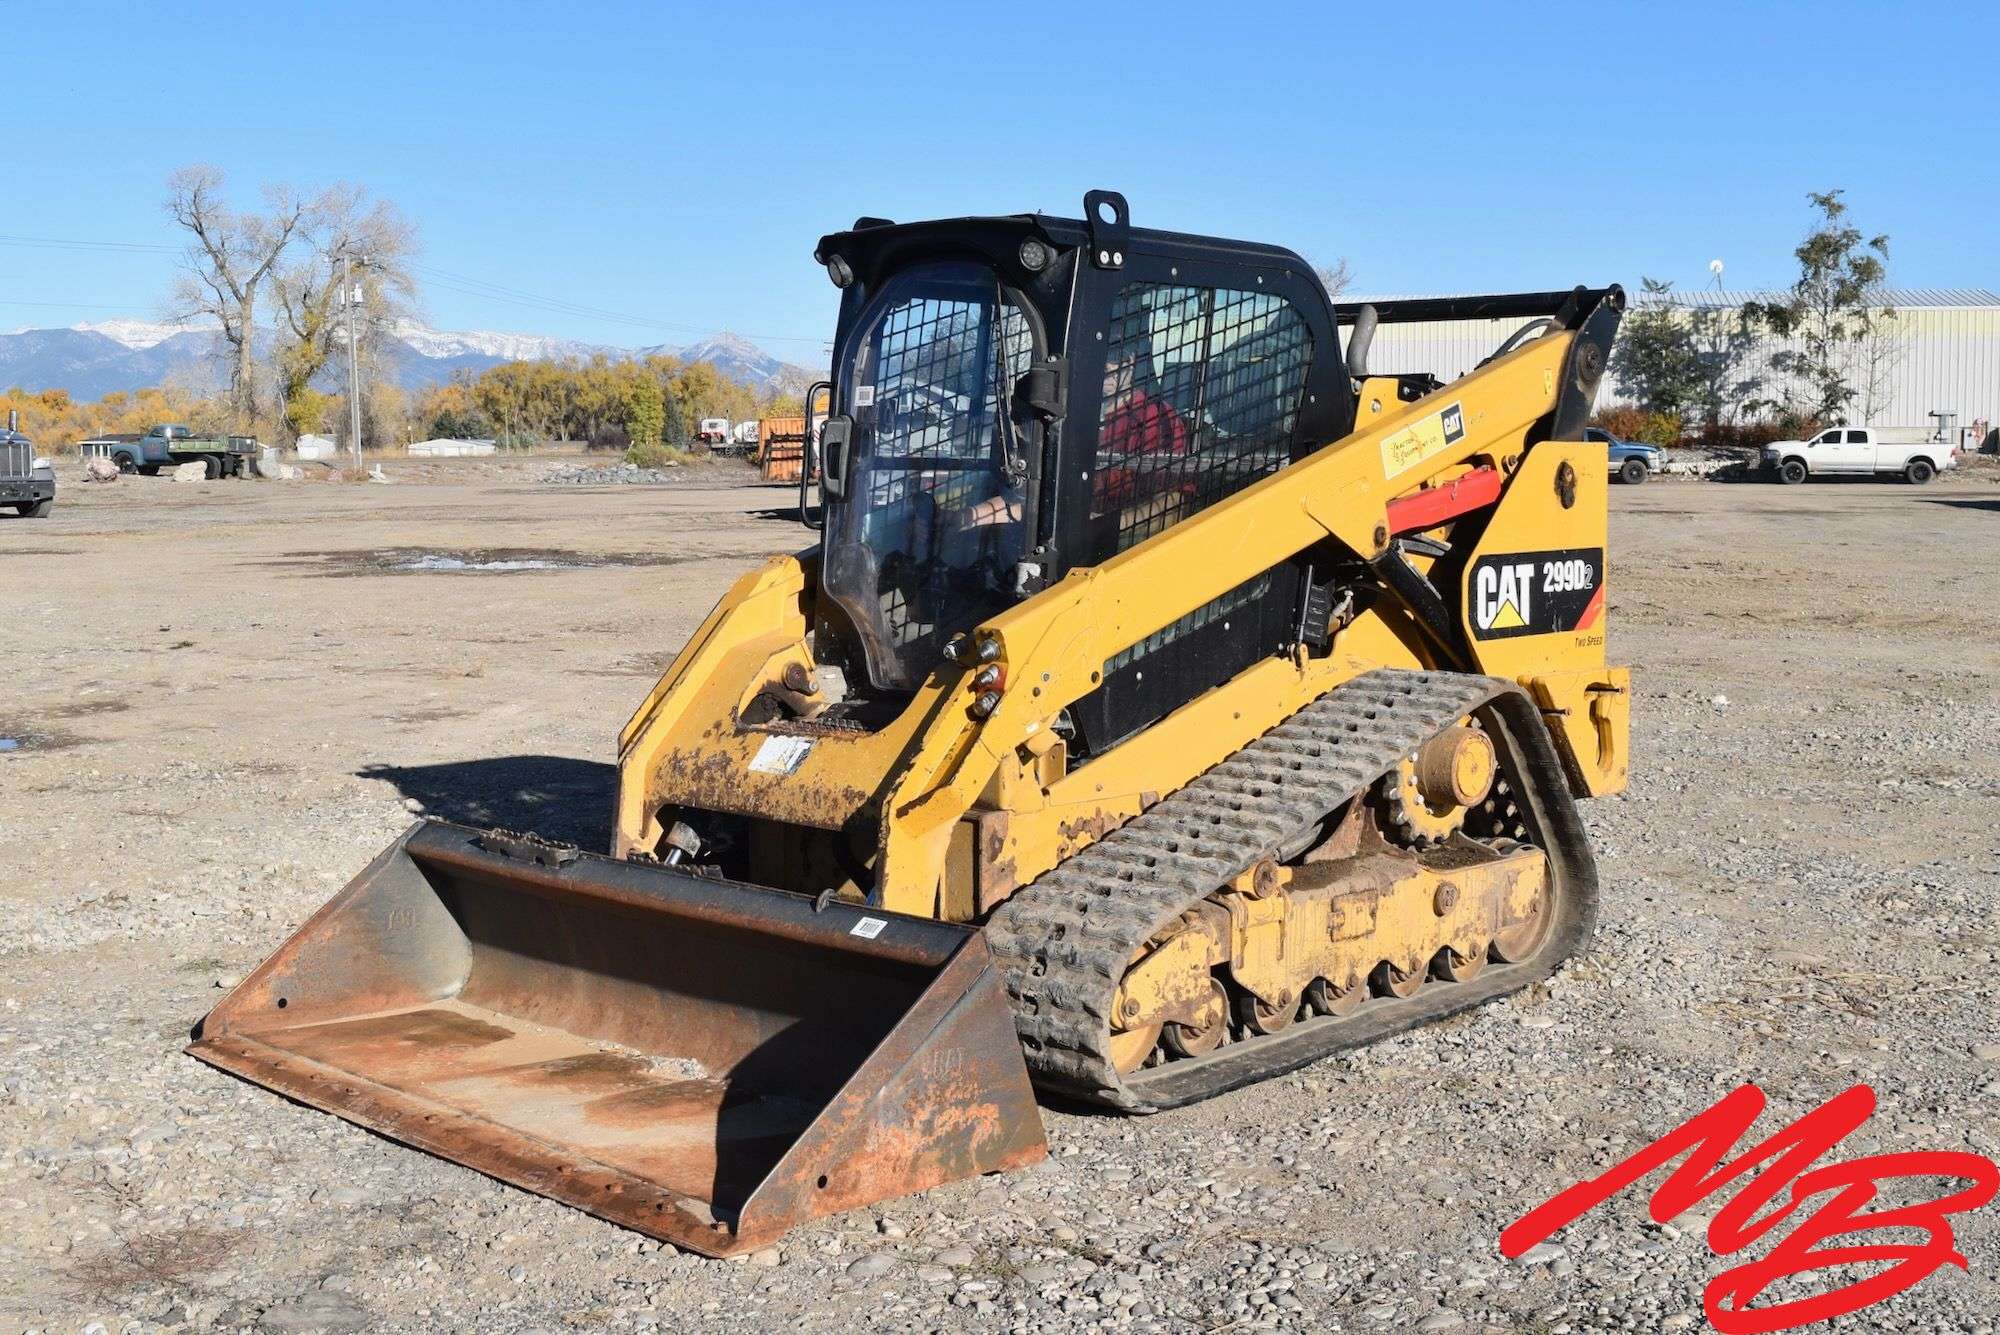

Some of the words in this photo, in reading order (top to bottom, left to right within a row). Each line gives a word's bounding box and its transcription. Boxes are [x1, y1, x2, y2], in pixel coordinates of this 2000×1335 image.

[1443, 412, 1461, 436] CAT
[1477, 563, 1535, 630] CAT
[1542, 559, 1593, 593] 299D2
